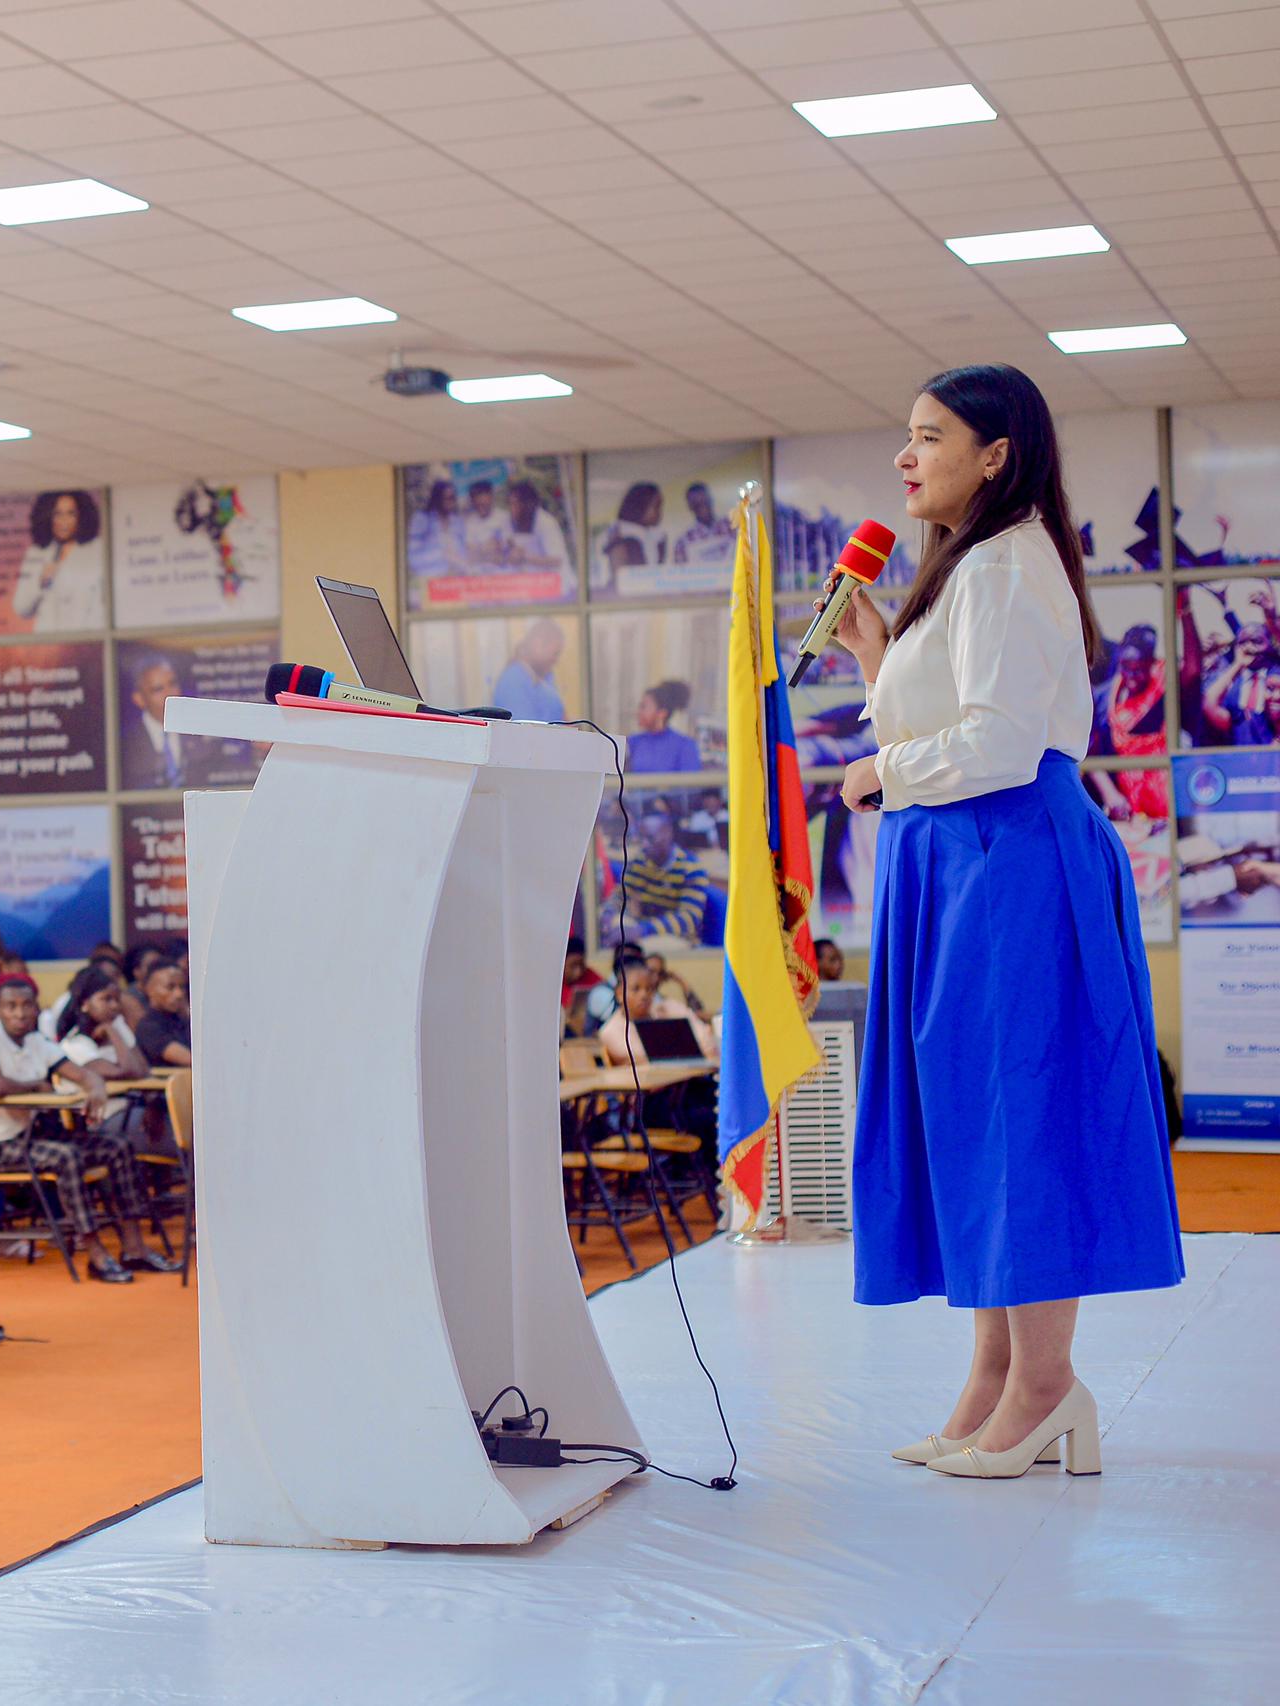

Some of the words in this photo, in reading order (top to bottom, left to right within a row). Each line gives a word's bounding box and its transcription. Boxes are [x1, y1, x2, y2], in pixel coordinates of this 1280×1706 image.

[2, 667, 23, 686] all
[24, 666, 80, 683] Storms
[8, 690, 25, 707] to
[26, 687, 84, 709] disrupt
[352, 696, 391, 706] SENNHEISER
[26, 734, 69, 751] come
[19, 757, 56, 778] your
[57, 751, 94, 776] path
[140, 835, 185, 859] Tod
[135, 912, 163, 930] will
